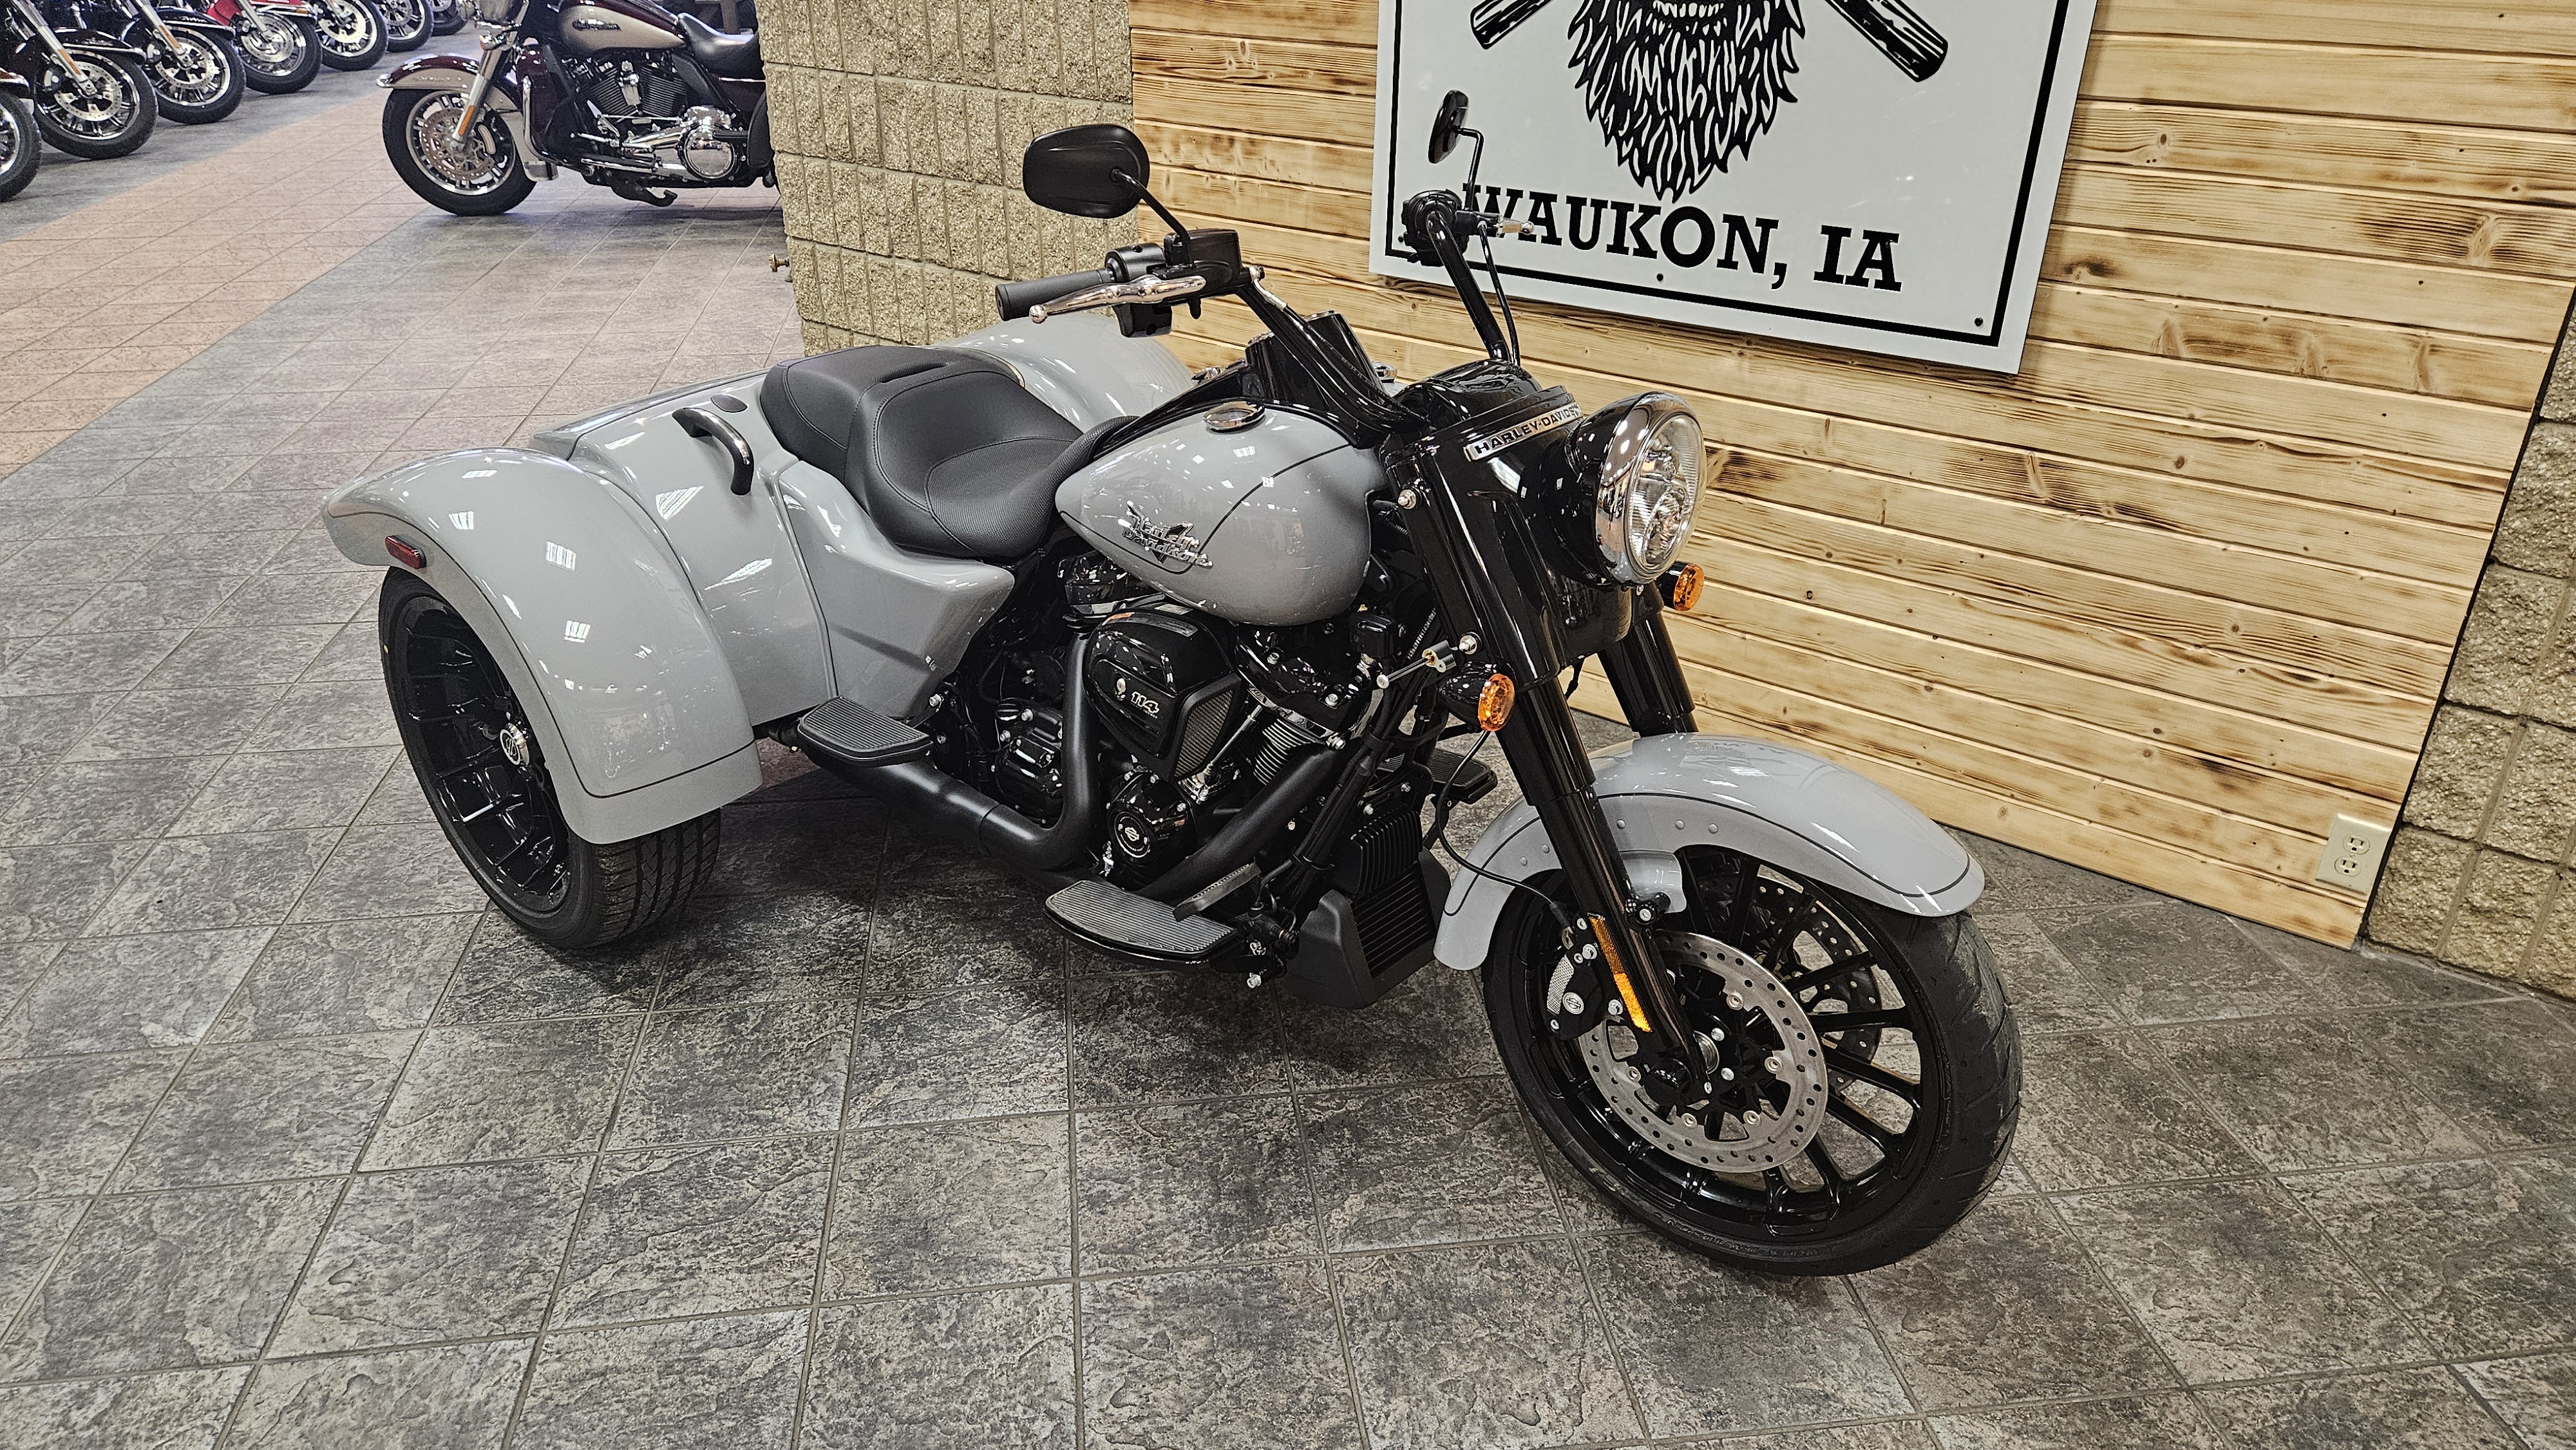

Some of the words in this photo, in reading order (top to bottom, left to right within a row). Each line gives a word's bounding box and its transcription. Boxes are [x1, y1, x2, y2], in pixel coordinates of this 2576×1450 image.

[1462, 182, 1788, 290] WAUKON,
[1813, 224, 1902, 292] IA
[1475, 404, 1580, 455] HARLEY-DAVIDS
[1130, 691, 1160, 714] 114
